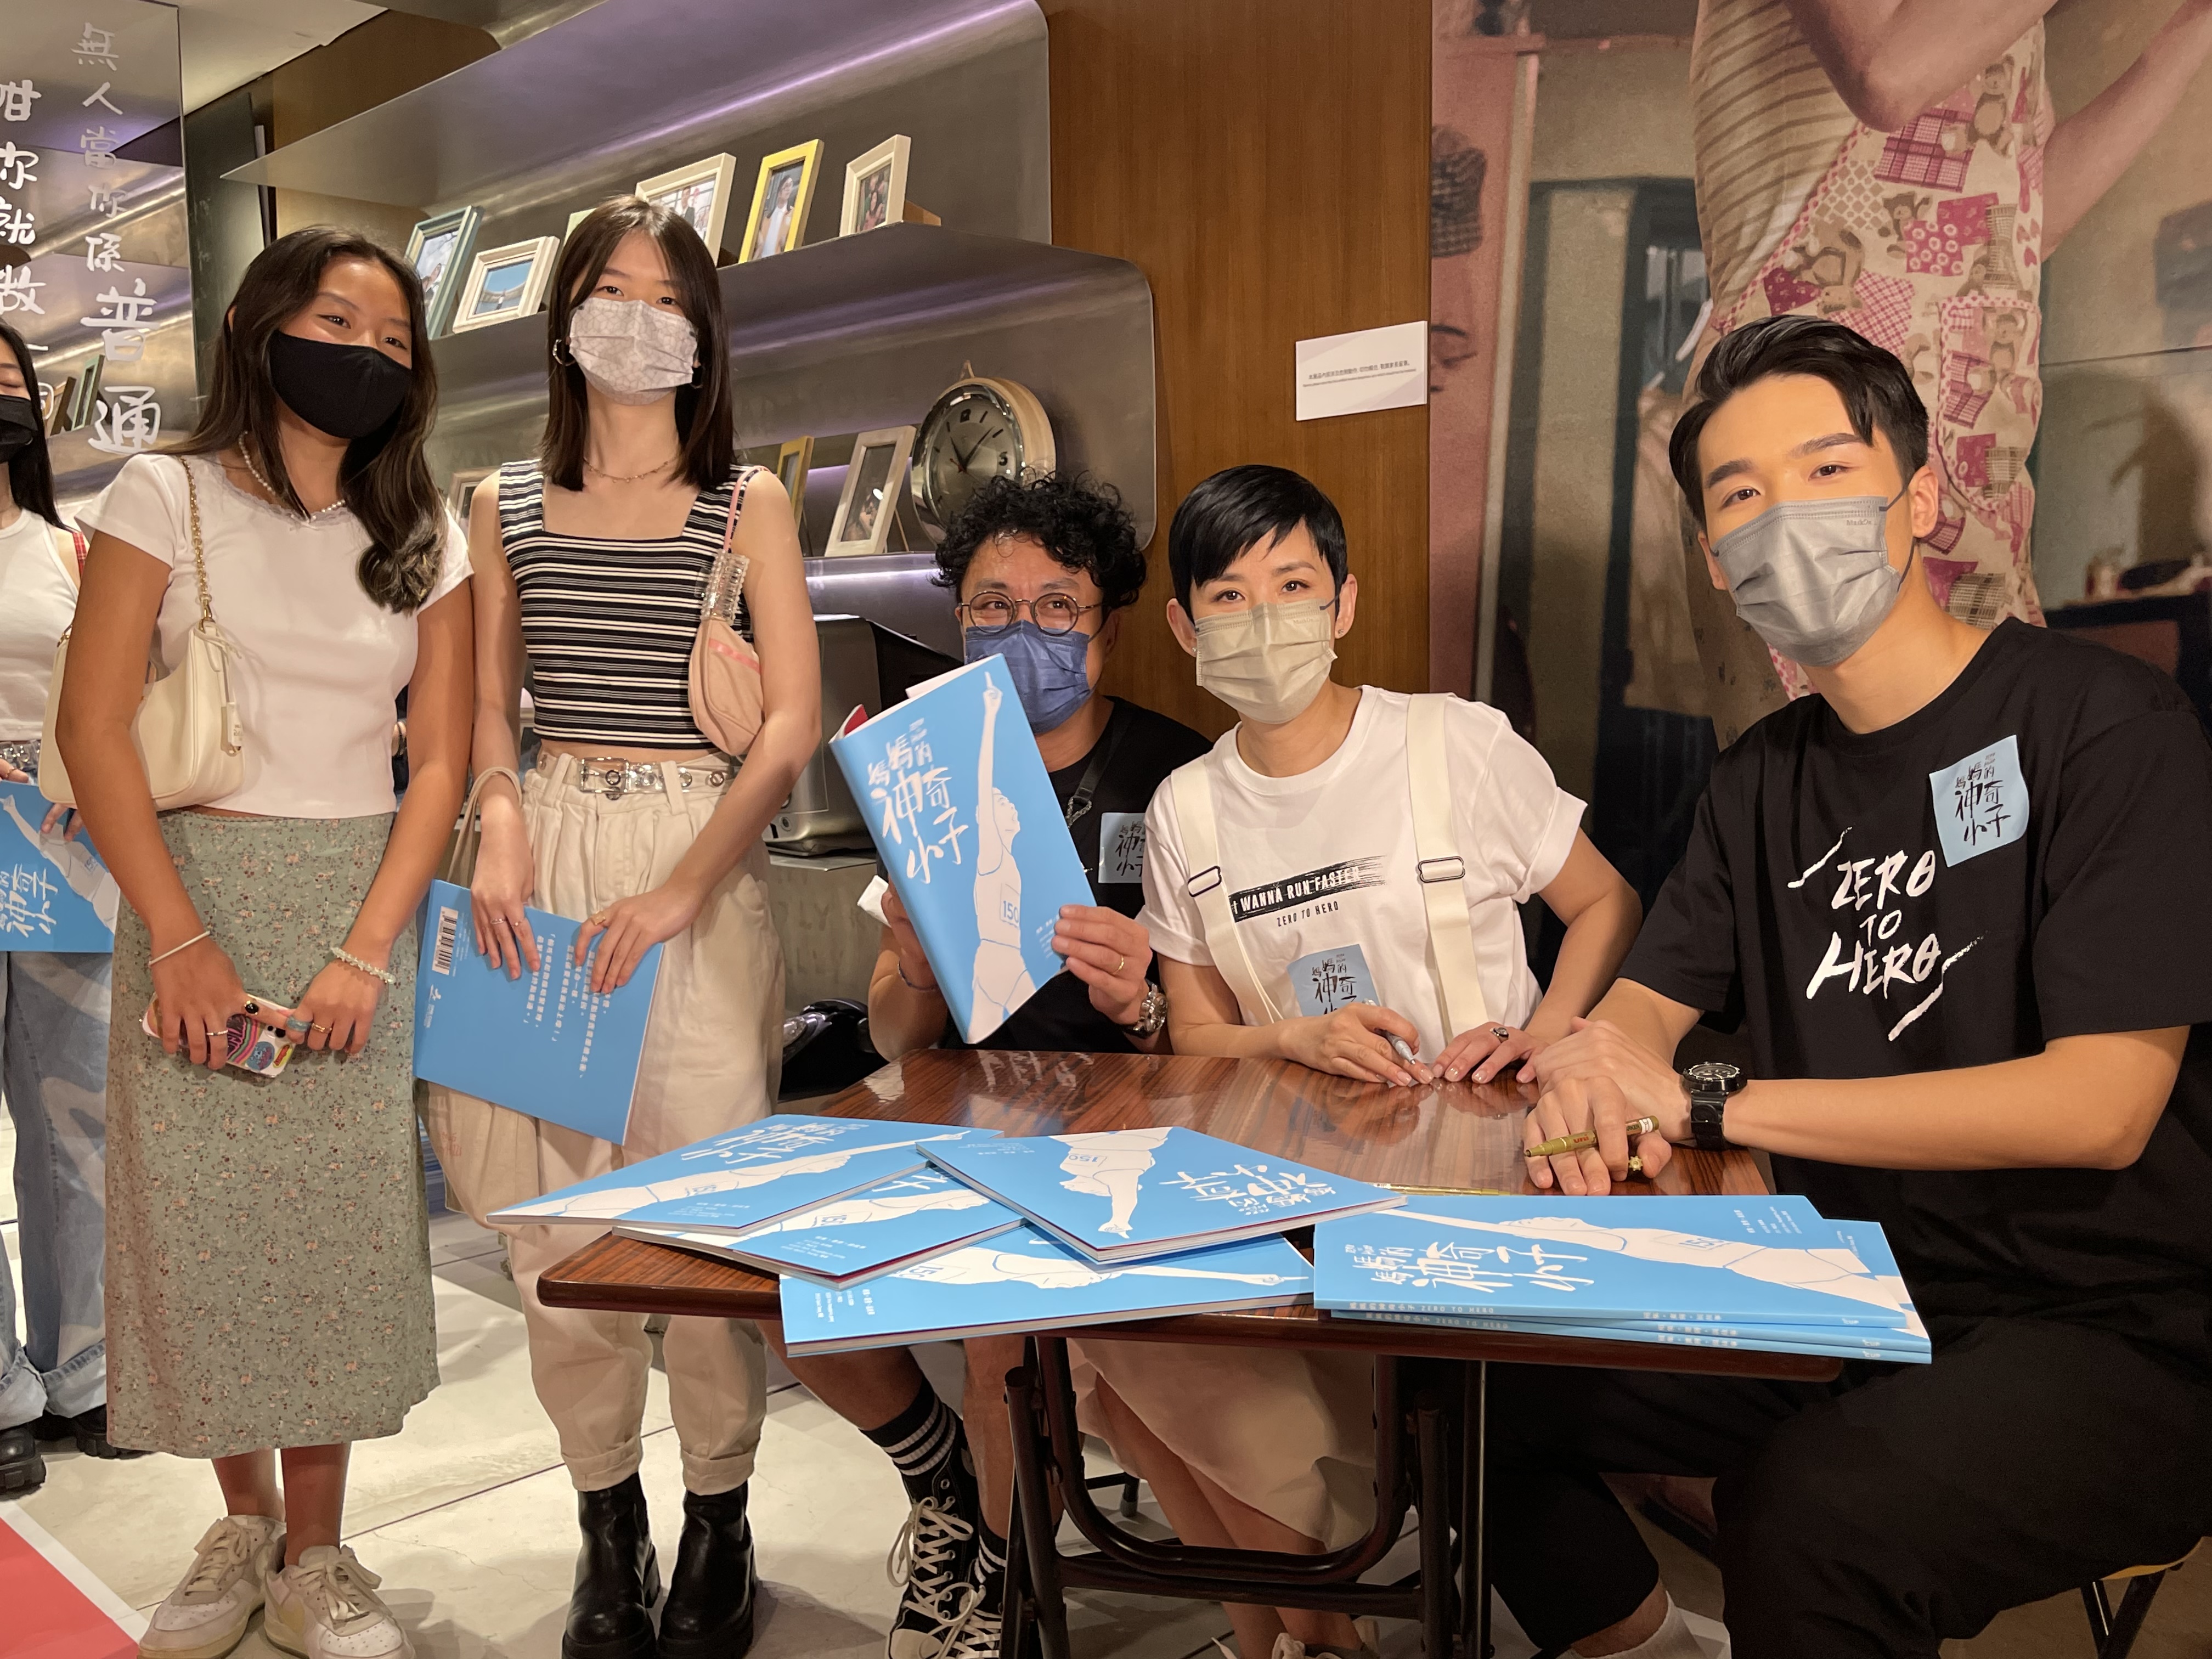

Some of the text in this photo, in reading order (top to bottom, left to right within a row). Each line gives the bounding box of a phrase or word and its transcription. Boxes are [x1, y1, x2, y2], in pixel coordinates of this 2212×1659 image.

[1240, 888, 1283, 912] WANNA
[1286, 882, 1311, 899] RUN
[1314, 866, 1361, 891] FASTER
[1832, 850, 1936, 910] ZERO
[1003, 900, 1019, 923] 150
[1277, 901, 1339, 927] ZERO TO HERO
[1860, 910, 1902, 946] TO
[1806, 932, 1941, 999] HERO
[1573, 1133, 1589, 1143] uni
